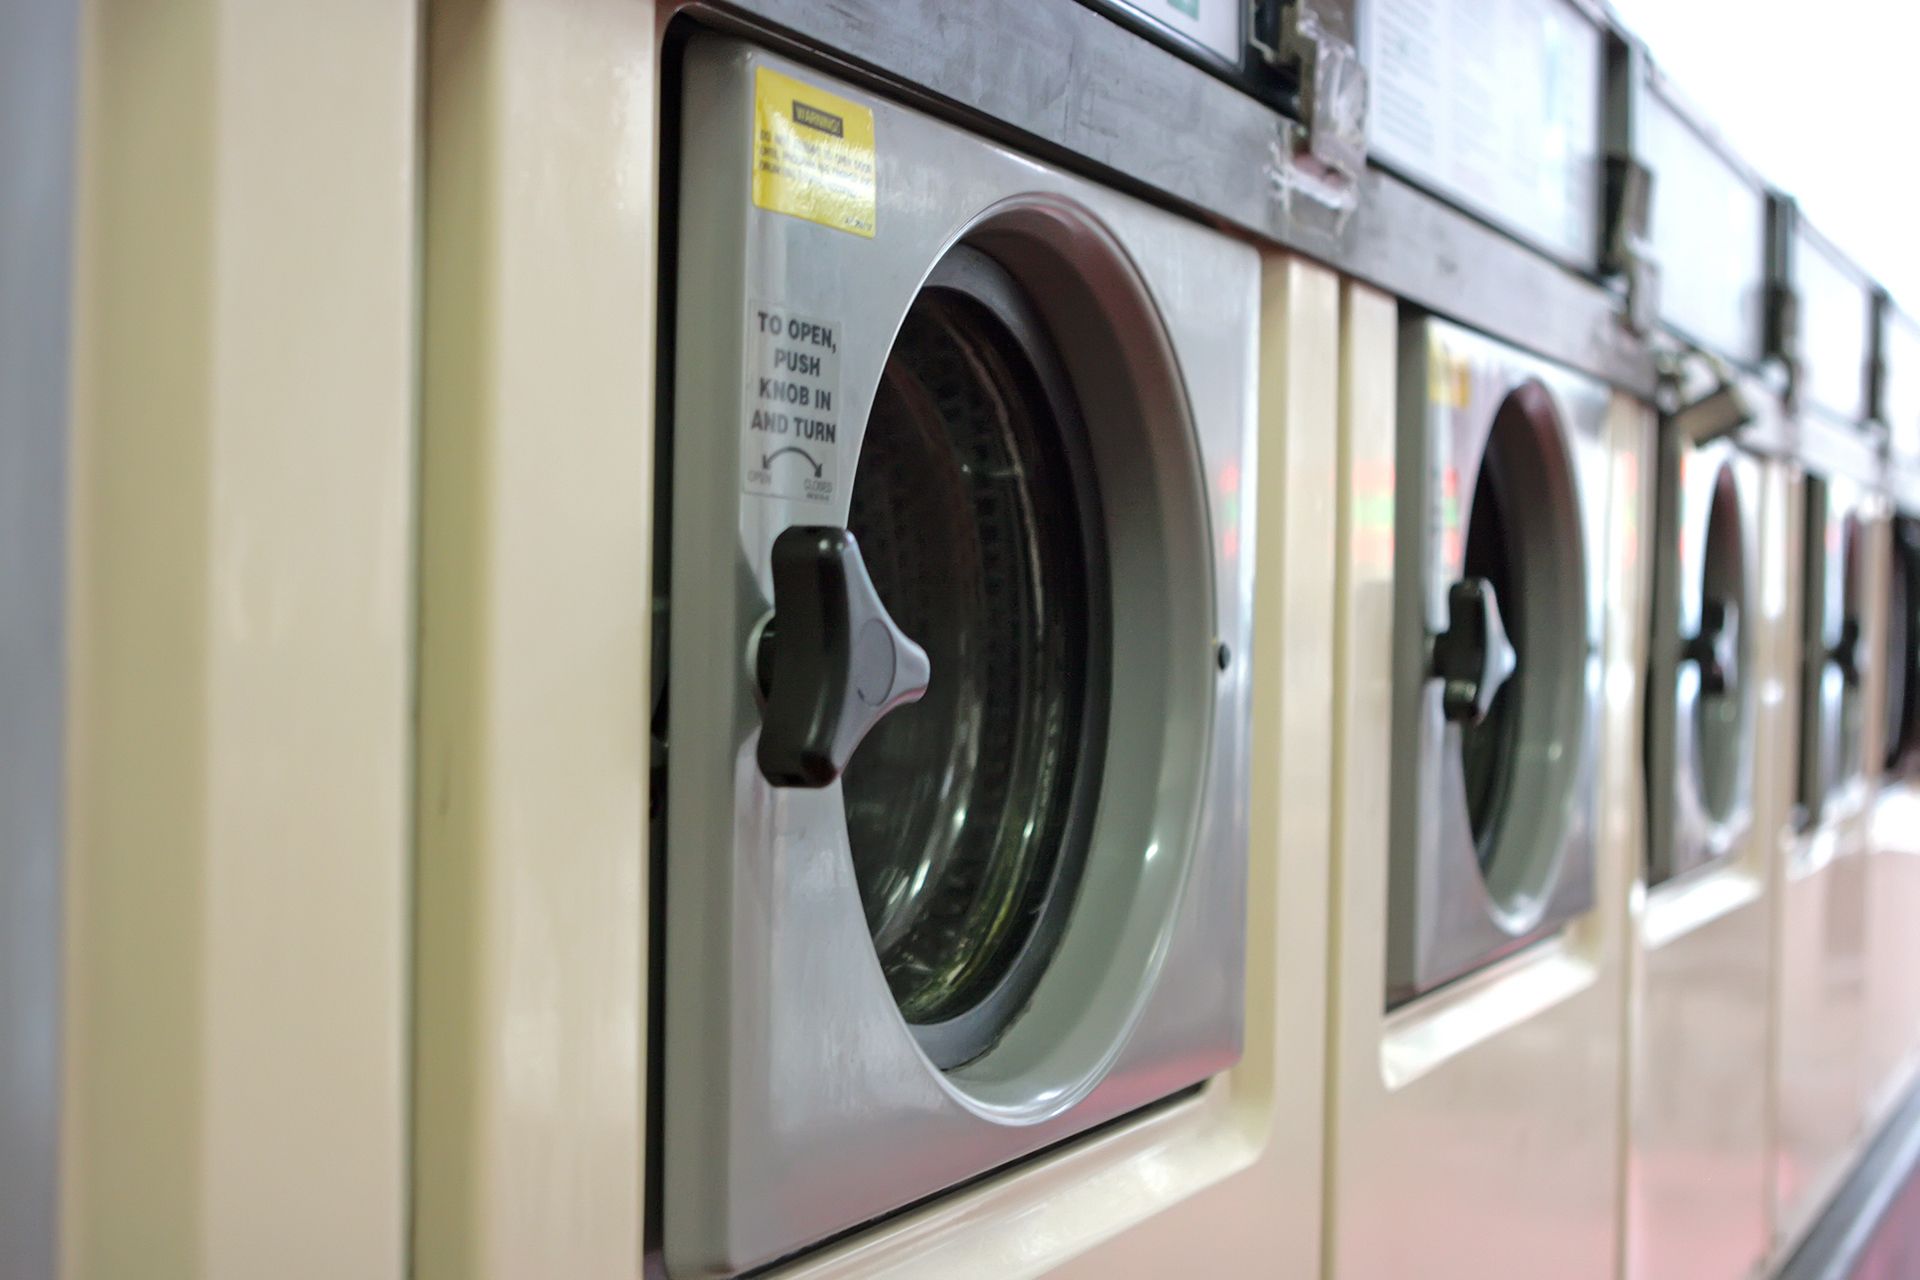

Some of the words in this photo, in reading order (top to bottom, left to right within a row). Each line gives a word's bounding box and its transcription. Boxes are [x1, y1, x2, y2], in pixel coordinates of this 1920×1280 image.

[758, 311, 782, 335] TO
[788, 319, 837, 353] OPEN,
[774, 348, 820, 377] PUSH
[759, 377, 809, 406] KNOB
[815, 389, 831, 411] IN
[751, 409, 788, 434] AND
[793, 417, 836, 443] TURN
[747, 470, 772, 485] OPEN
